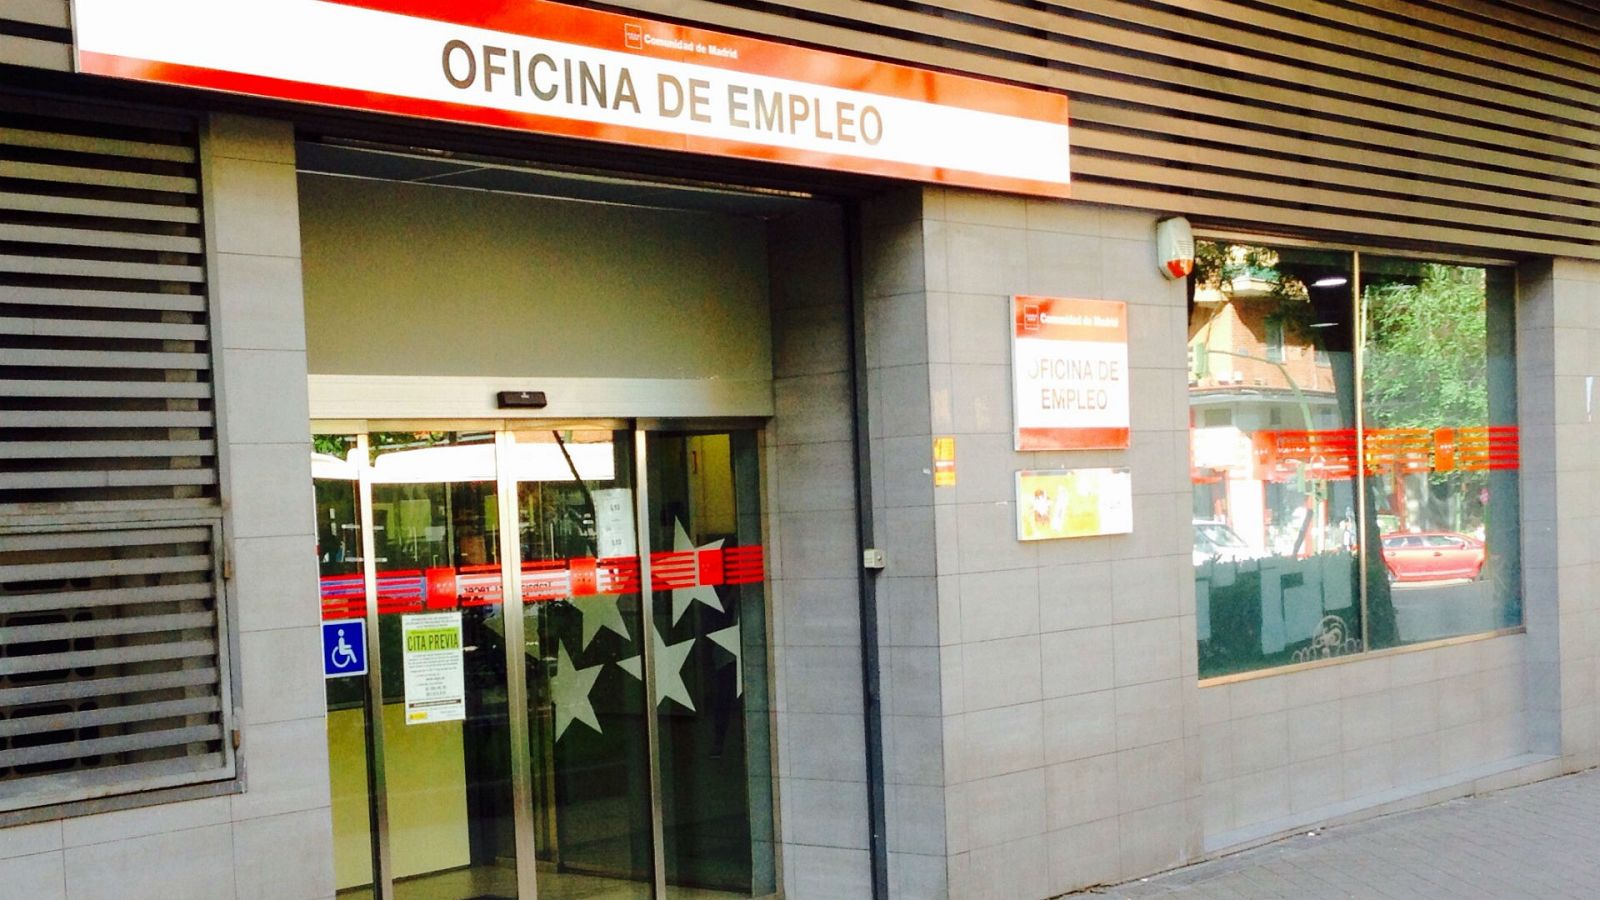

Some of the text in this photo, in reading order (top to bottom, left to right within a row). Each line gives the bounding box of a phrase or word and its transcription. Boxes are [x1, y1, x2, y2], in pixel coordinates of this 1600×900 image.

[644, 34, 693, 50] Comunidad
[696, 43, 706, 53] de
[708, 46, 738, 59] Madrid
[442, 39, 883, 145] OFICINA DE EMPLEO
[1099, 360, 1119, 381] DE
[1042, 389, 1107, 409] EMPLEO
[408, 633, 459, 651] CITA PREVIA
